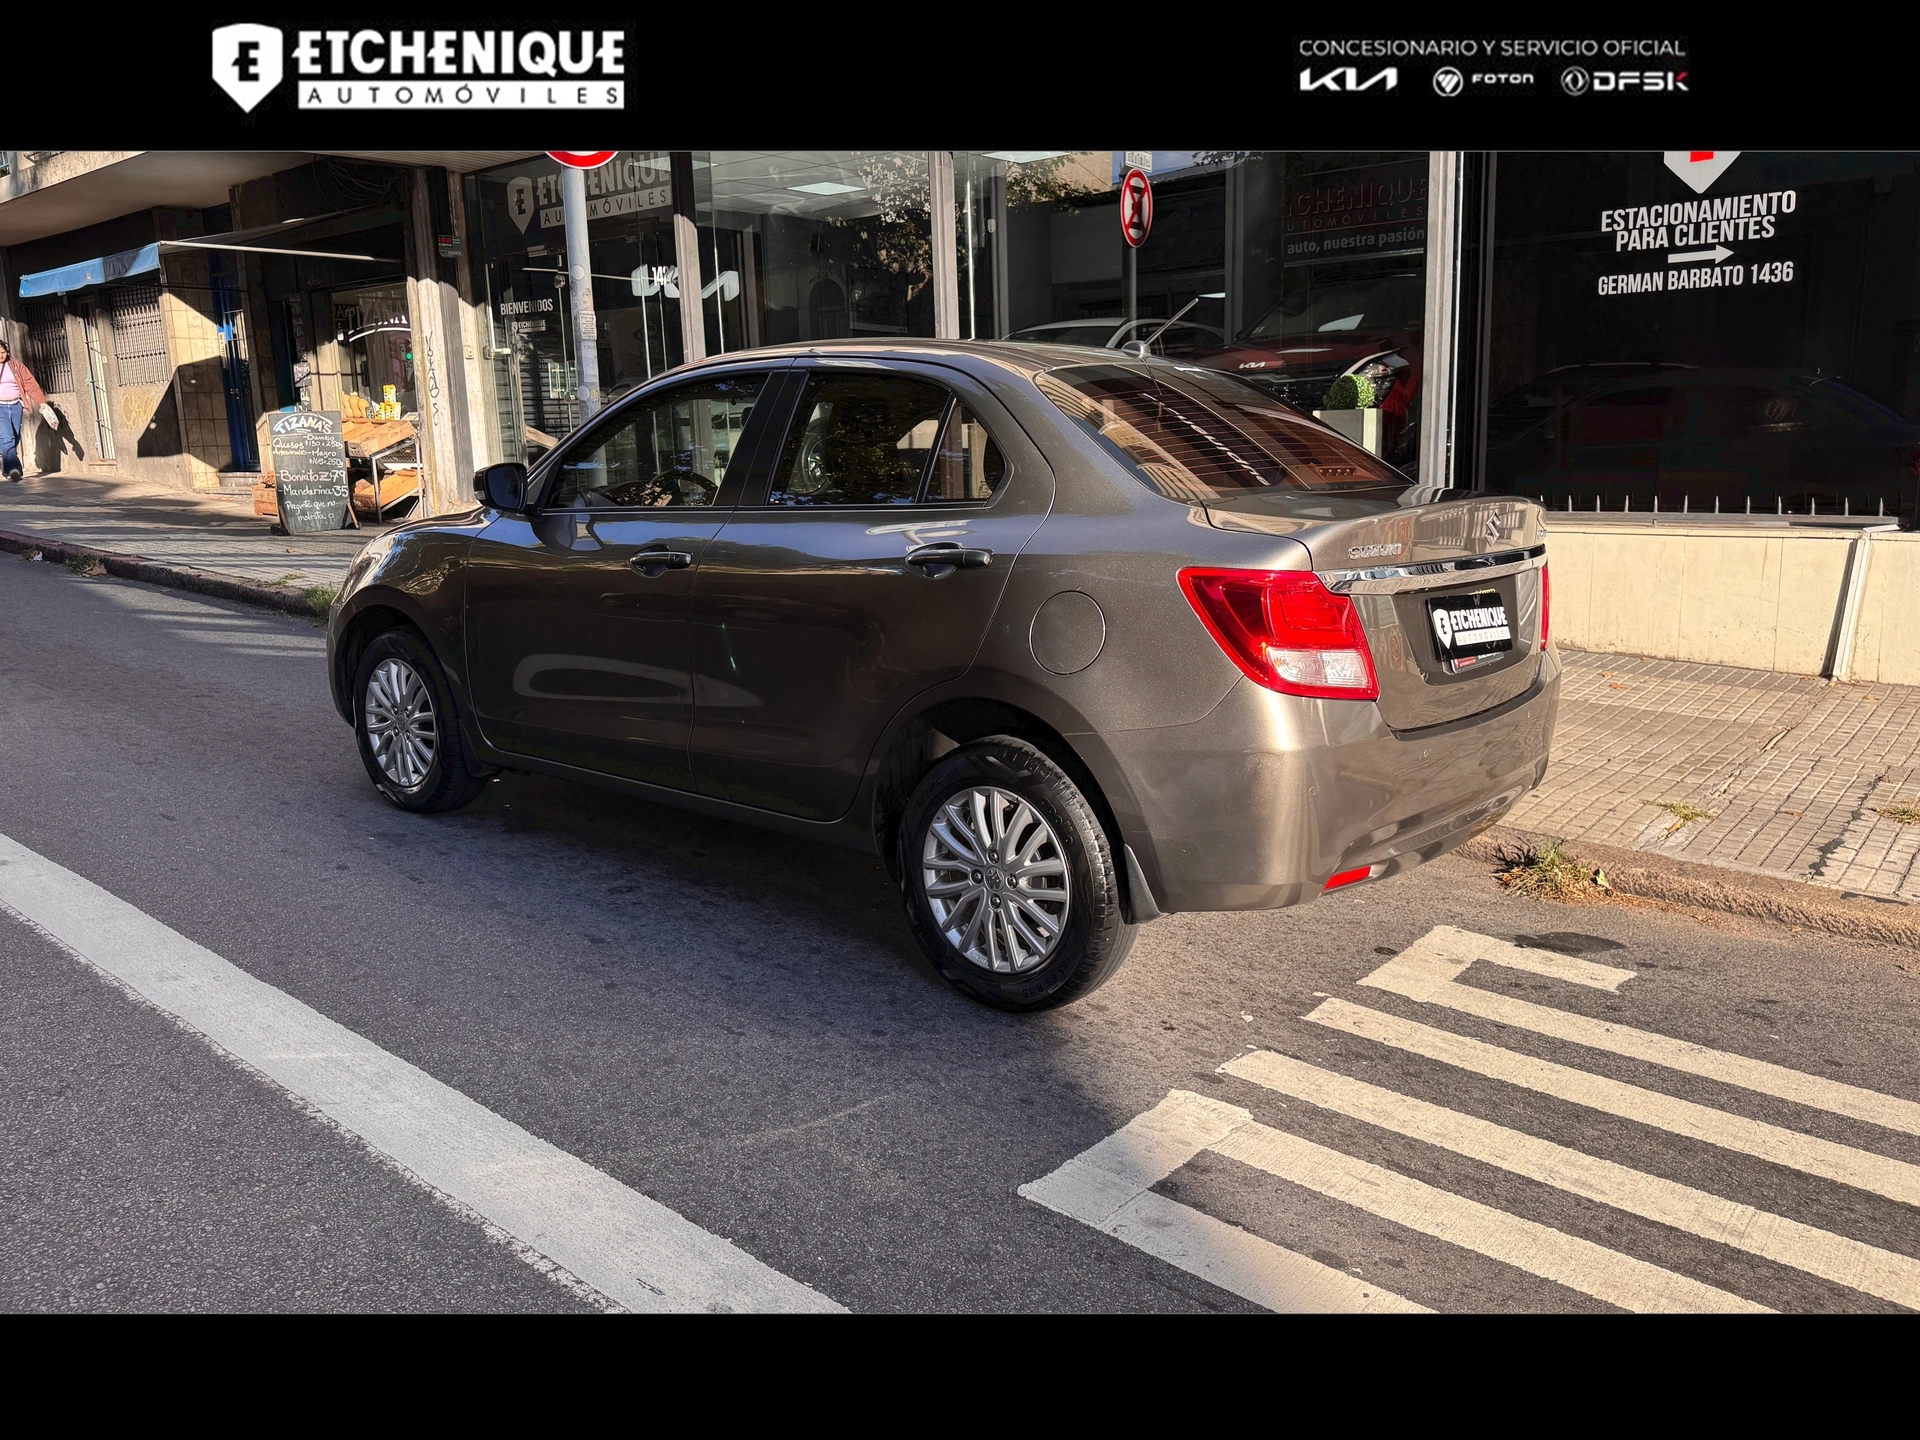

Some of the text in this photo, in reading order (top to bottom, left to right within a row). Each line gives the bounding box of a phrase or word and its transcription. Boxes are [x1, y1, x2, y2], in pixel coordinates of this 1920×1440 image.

[536, 151, 670, 206] ETENIQUE
[543, 189, 667, 226] AUMÓVILES
[1601, 190, 1797, 233] ESTACIONAMIENTO
[1323, 234, 1376, 251] nuestra
[1378, 226, 1425, 248] pasión
[1616, 215, 1776, 252] PARA CLIENTES
[1598, 261, 1795, 296] GERMAN BARBATO 1436
[500, 298, 554, 316] BIENVENIDOS
[1238, 361, 1267, 370] KIA
[274, 415, 332, 434] TIZANA'S
[272, 437, 305, 449] Quesos
[1348, 543, 1402, 559] SUZUKI
[1449, 606, 1508, 631] ETCHENIQUE
